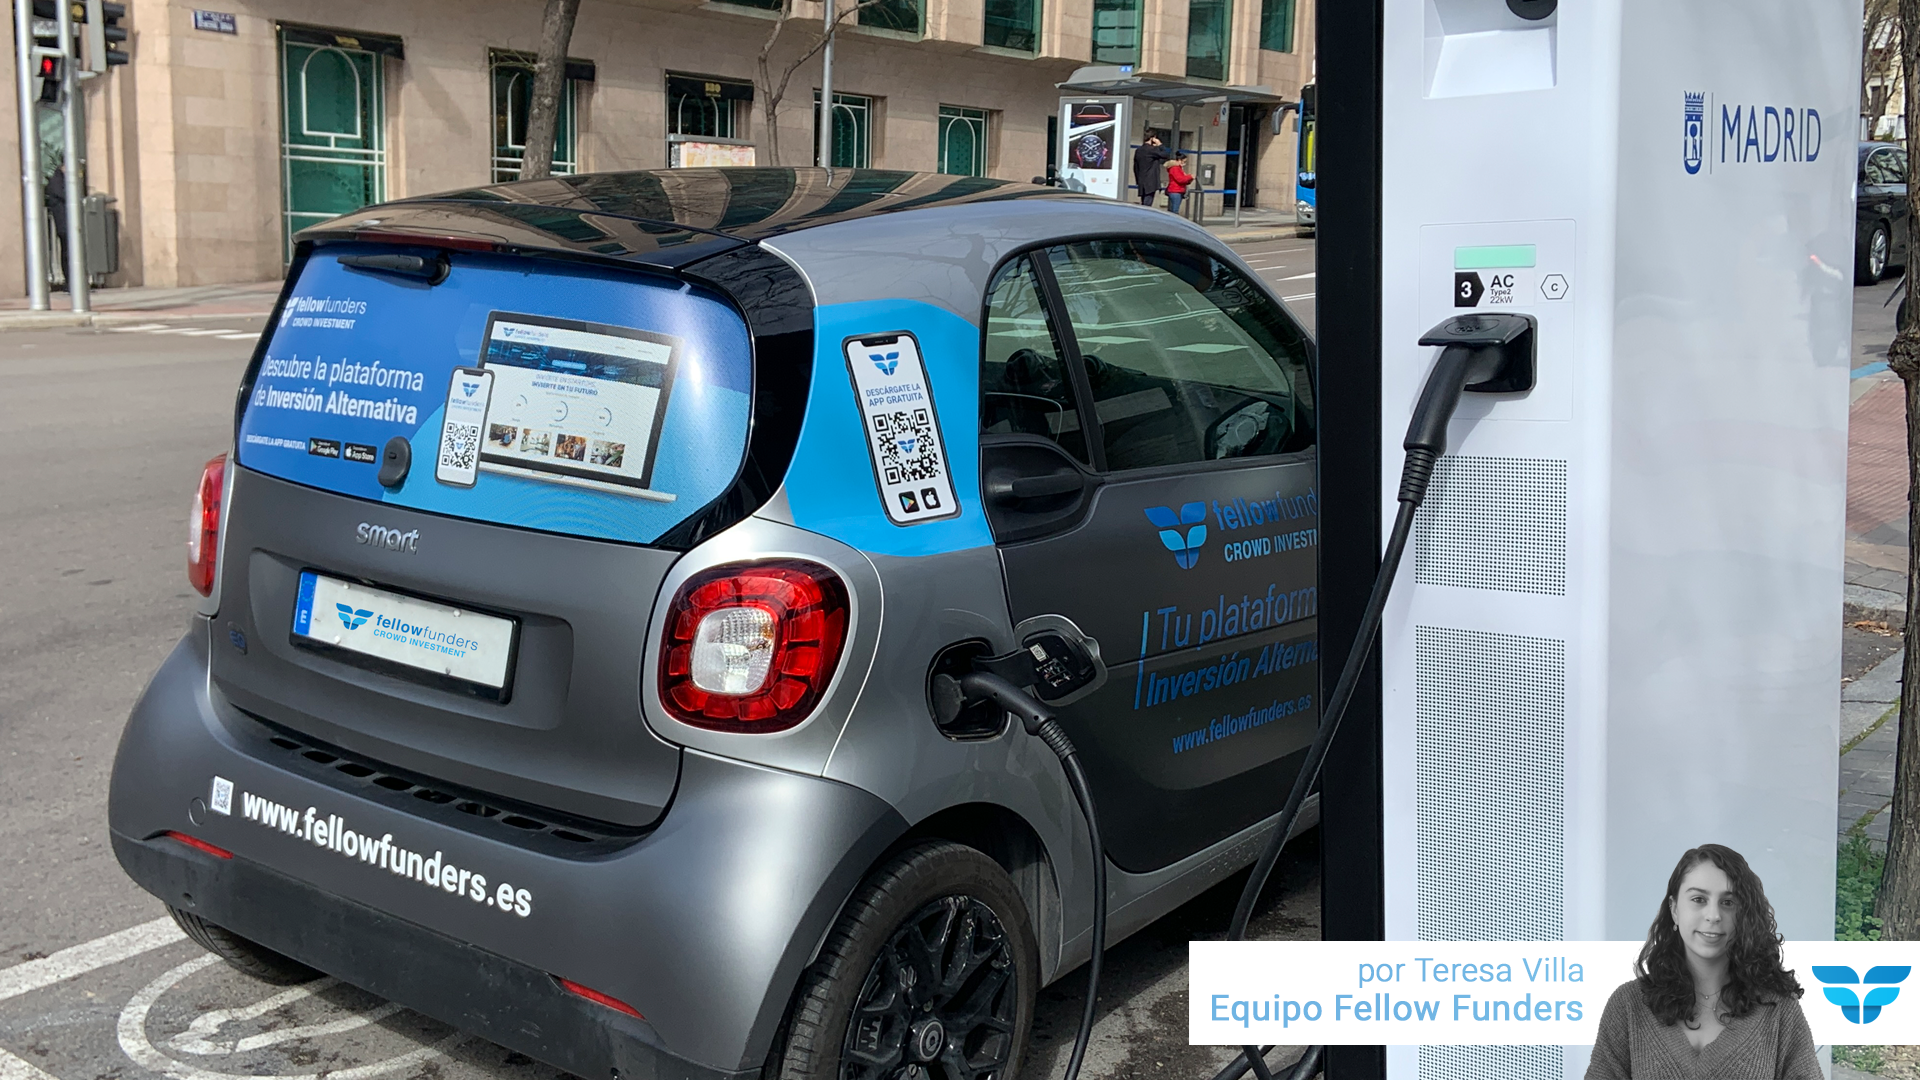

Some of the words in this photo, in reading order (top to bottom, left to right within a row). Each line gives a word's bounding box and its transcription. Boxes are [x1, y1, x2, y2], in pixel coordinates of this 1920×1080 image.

[1721, 104, 1822, 163] MADRID
[1460, 281, 1472, 298] 3
[1490, 274, 1515, 288] AC
[1490, 288, 1512, 296] Type2
[296, 295, 367, 315] fellowfunders
[1490, 296, 1514, 304] 22kW
[292, 317, 313, 327] CROWD
[313, 317, 356, 329] INVESTMENT
[262, 353, 312, 380] Descubre
[313, 355, 326, 379] la
[329, 358, 424, 391] plataforma
[865, 384, 910, 397] DESCÁRGATE
[911, 383, 921, 392] LA
[869, 397, 885, 407] APP
[886, 392, 924, 404] GRATUITA
[254, 385, 265, 406] de
[266, 387, 323, 412] Inversión
[325, 390, 418, 425] Alternativa
[355, 522, 421, 555] smart
[1224, 537, 1272, 562] CROWD
[300, 609, 308, 624] E
[1157, 606, 1192, 650] Tu
[373, 628, 407, 644] CROWD
[409, 636, 467, 659] INVESTMENT
[376, 614, 479, 651] fellowfunders
[1146, 651, 1250, 707] Inversión
[1172, 694, 1312, 754] www.fellowfunders.es
[242, 790, 533, 918] www.fellowfunders.es
